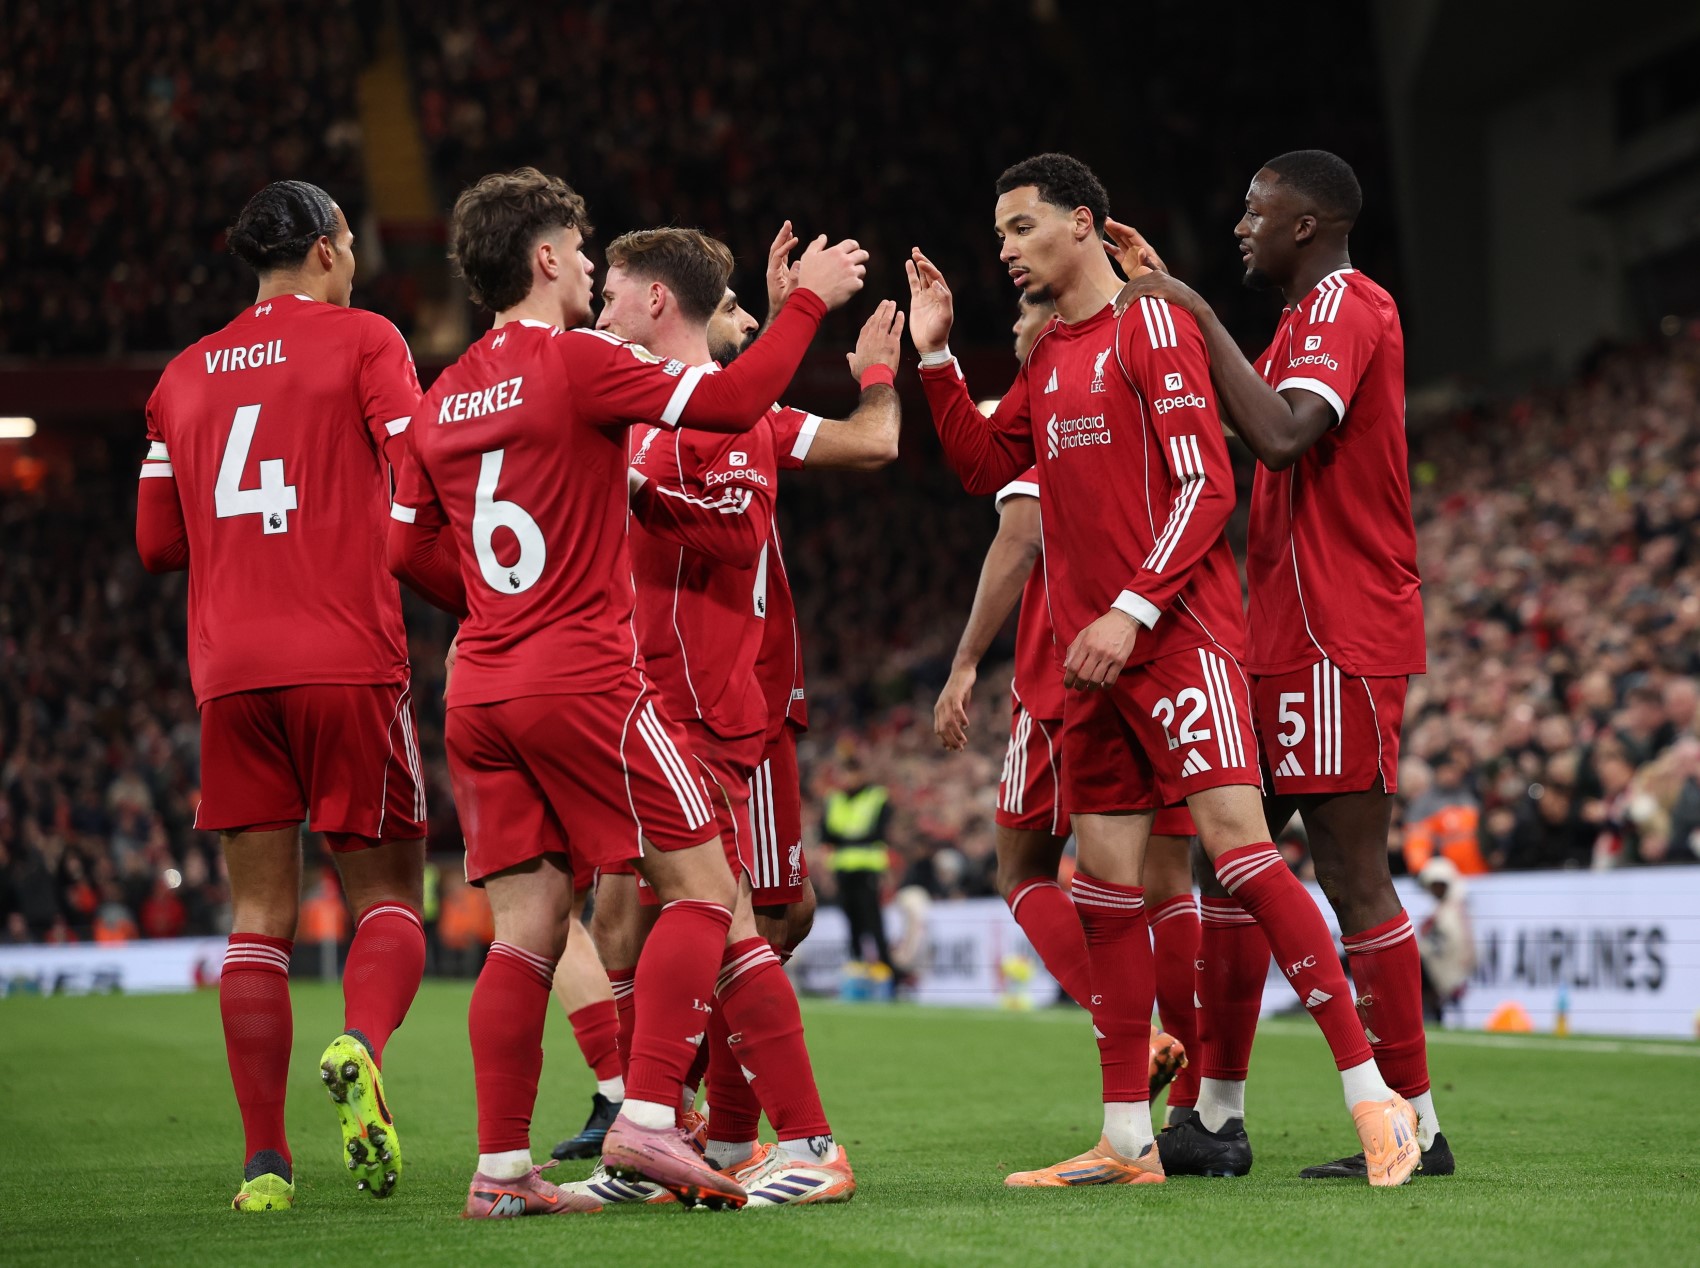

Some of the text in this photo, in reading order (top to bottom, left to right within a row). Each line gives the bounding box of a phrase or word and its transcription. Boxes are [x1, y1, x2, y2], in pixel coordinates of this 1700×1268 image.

[205, 339, 287, 374] VIRGIL
[1287, 352, 1339, 371] xpedia
[438, 376, 523, 425] KERKEZ
[1060, 413, 1105, 434] standard
[1060, 428, 1111, 450] chartered
[214, 403, 298, 535] 4
[705, 468, 768, 487] Expedia
[472, 448, 547, 595] 6
[1151, 687, 1212, 751] 22
[1277, 692, 1306, 748] 5
[1286, 955, 1317, 978] LFC
[1512, 927, 1667, 991] AIRLINES
